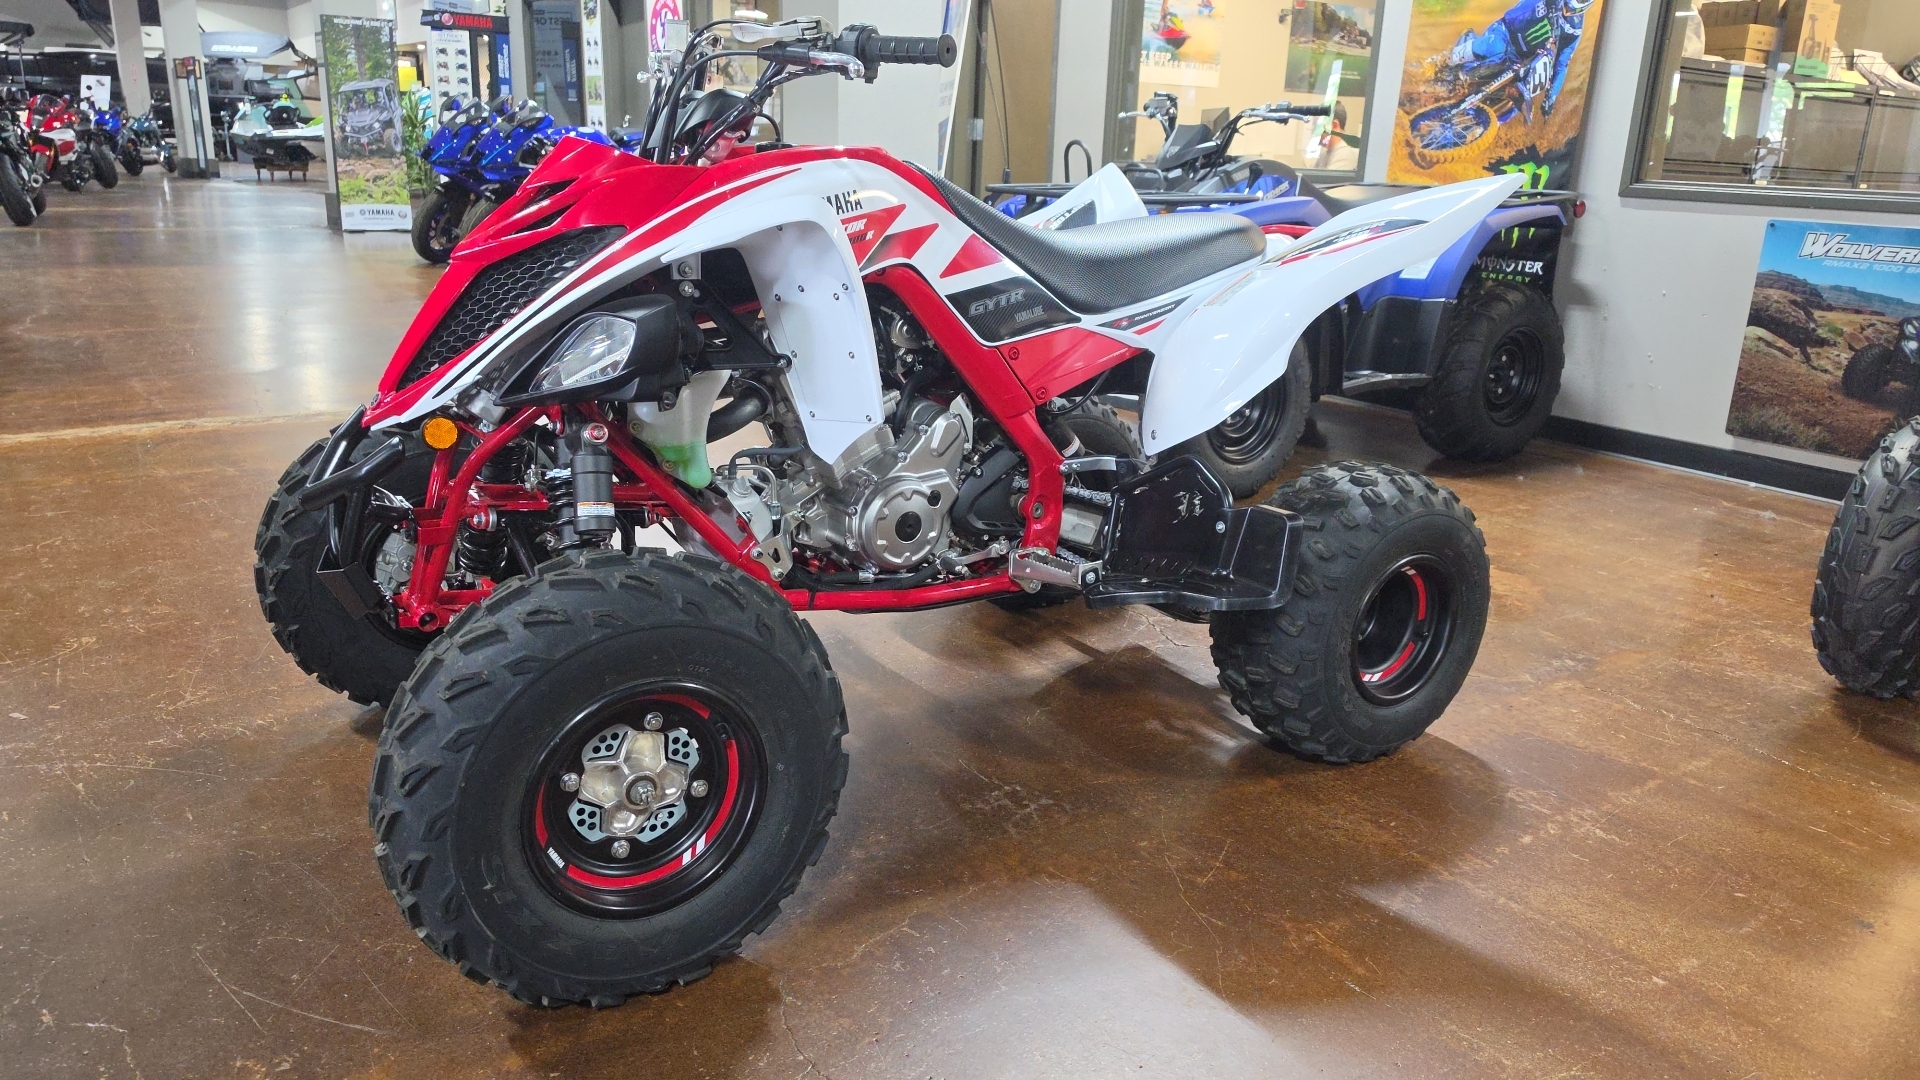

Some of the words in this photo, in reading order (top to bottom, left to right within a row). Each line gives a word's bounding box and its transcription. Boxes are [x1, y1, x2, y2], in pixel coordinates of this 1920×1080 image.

[453, 14, 493, 29] YAMAHA
[1153, 59, 1181, 69] WATER
[1185, 62, 1220, 72] WAITING
[367, 208, 395, 217] YAMAHA
[1473, 254, 1544, 276] MONSTER
[1822, 259, 1870, 271] RMAX2
[1872, 263, 1904, 273] 1000
[1481, 271, 1531, 284] ENERGY
[968, 287, 1026, 318] GYTR
[1013, 305, 1045, 323] YAMALUBE
[547, 847, 566, 869] YAMAHA
